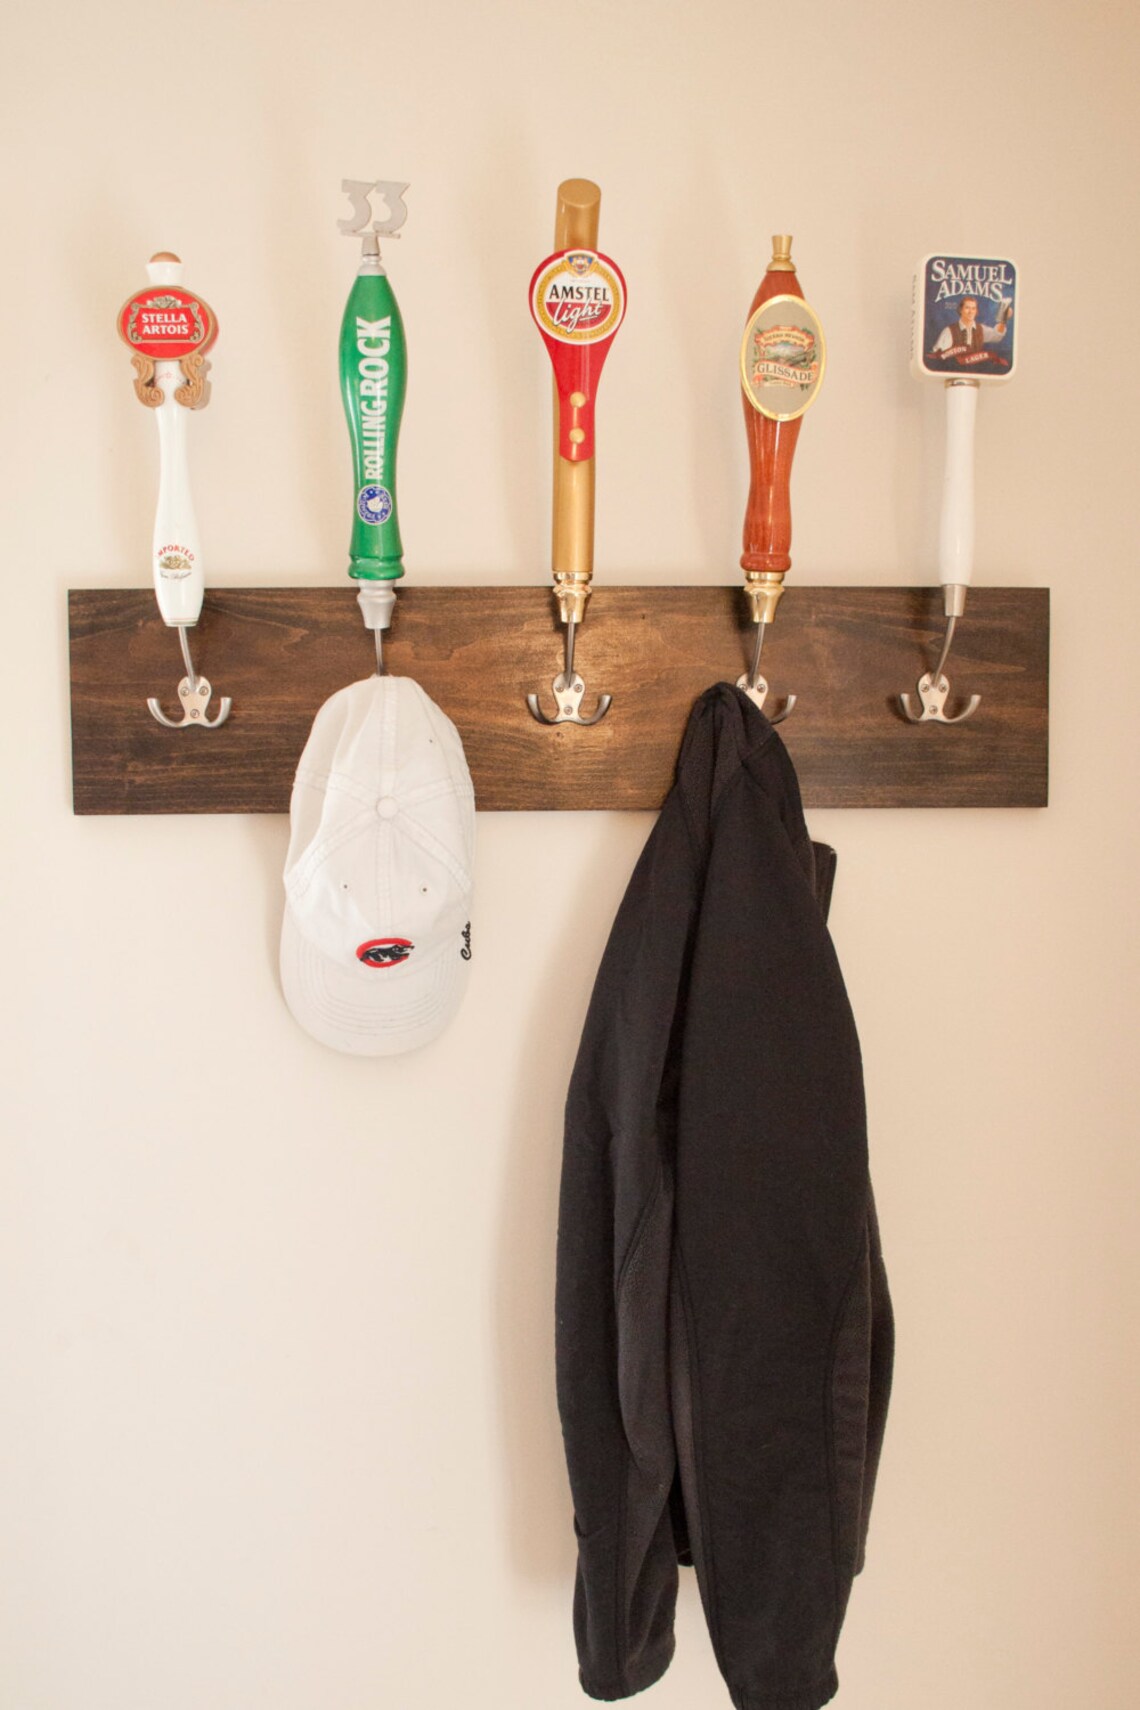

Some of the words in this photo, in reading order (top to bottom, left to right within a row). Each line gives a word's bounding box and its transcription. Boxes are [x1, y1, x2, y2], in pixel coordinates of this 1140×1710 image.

[931, 260, 1012, 284] SAMUEL
[549, 284, 609, 301] AMSTEL
[935, 280, 1003, 303] ADAMS
[141, 313, 188, 323] STELLA
[142, 325, 189, 335] ARTOIS
[757, 363, 813, 381] GLISSADE
[460, 921, 472, 961] Cubs
